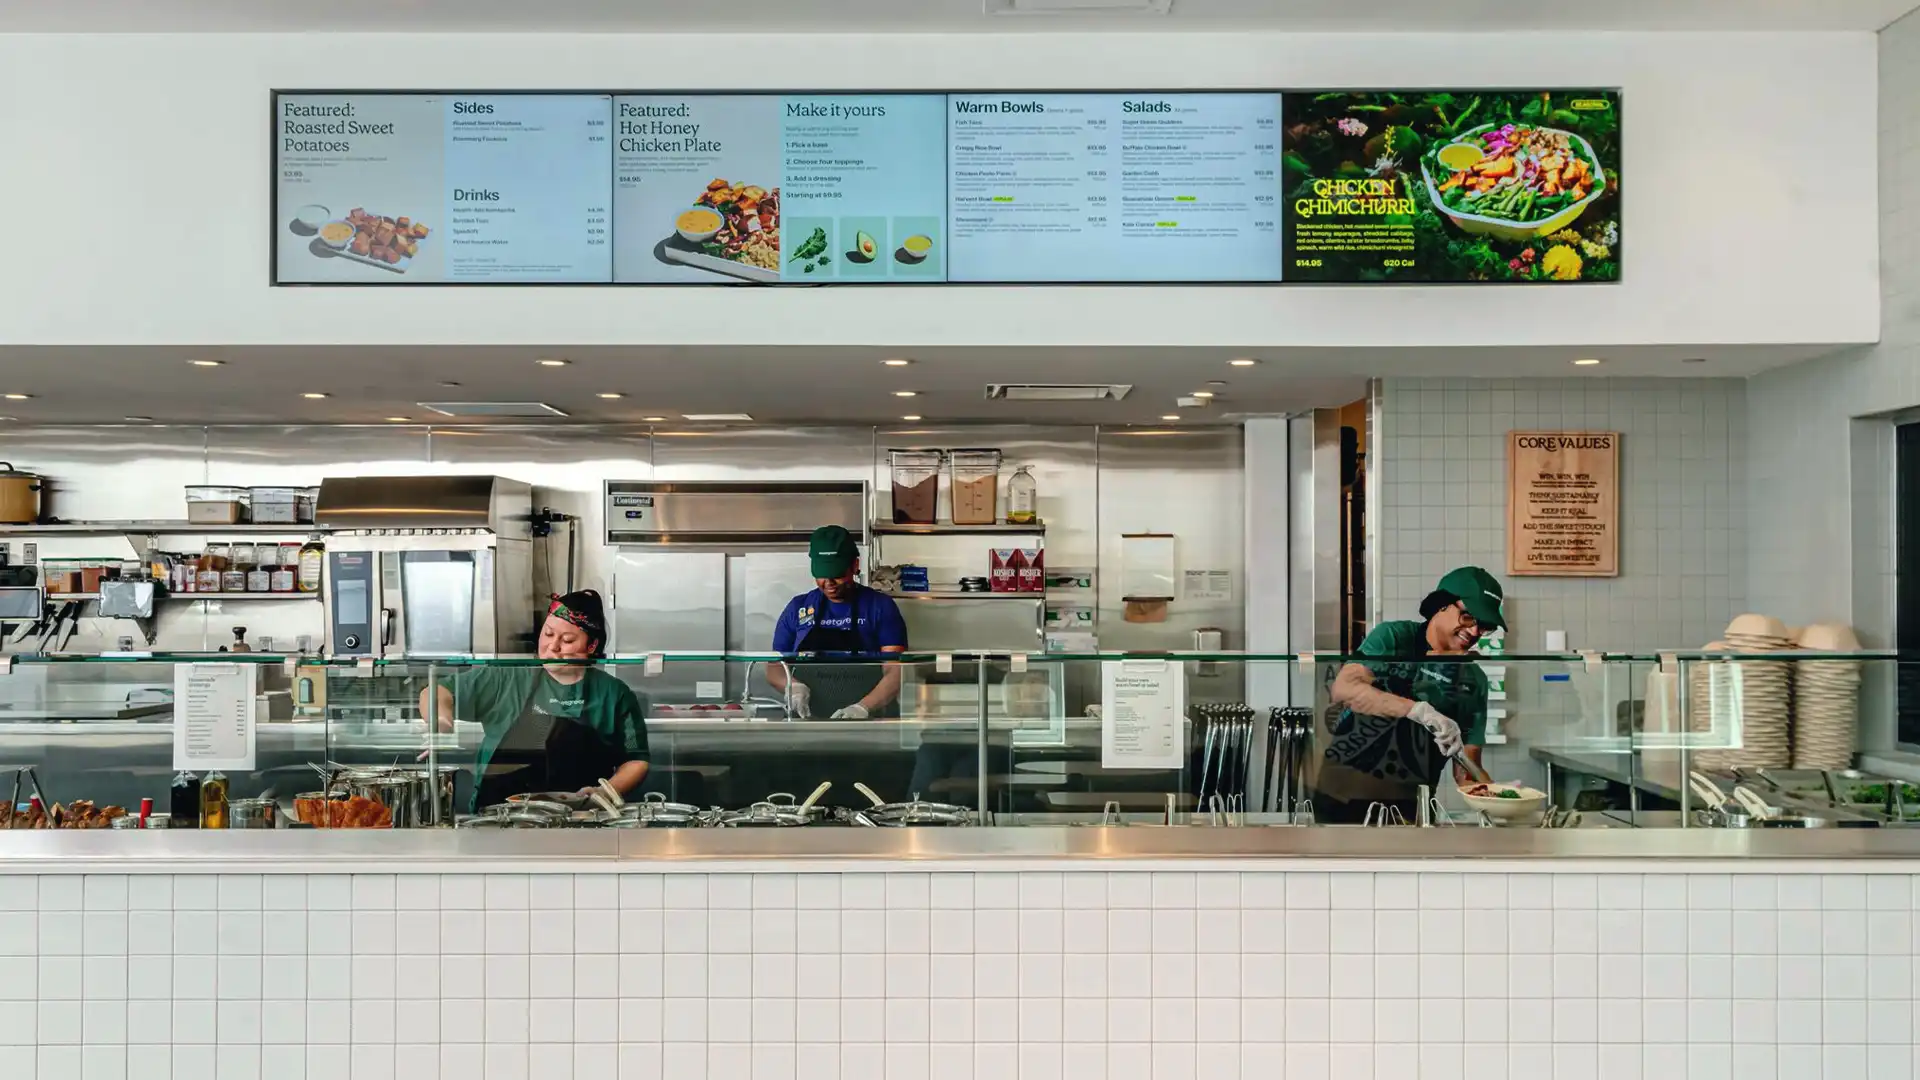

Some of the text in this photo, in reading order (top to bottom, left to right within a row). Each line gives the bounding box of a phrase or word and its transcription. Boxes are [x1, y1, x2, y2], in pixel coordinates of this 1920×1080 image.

[285, 103, 355, 117] Featured:
[453, 102, 494, 114] Sides
[620, 103, 690, 117] Featured:
[787, 103, 886, 119] Make it yours
[956, 101, 997, 113] Warm
[1001, 101, 1044, 113] Bowls
[1123, 101, 1171, 113] Salads
[285, 120, 394, 134] Roasted Sweet
[620, 121, 699, 137] Hot Honey
[285, 138, 350, 151] Potatoes
[620, 138, 722, 152] Chicken Plate
[453, 189, 500, 201] Drinks
[1314, 179, 1395, 198] CHICKEN
[1295, 198, 1415, 217] CHIMICHURRI
[1296, 259, 1322, 267] $14.95
[1384, 259, 1415, 267] 620 Cal
[1518, 437, 1610, 452] CORE VALUES
[1551, 492, 1599, 500] SUSTAINABLY
[807, 617, 866, 626] seetgren
